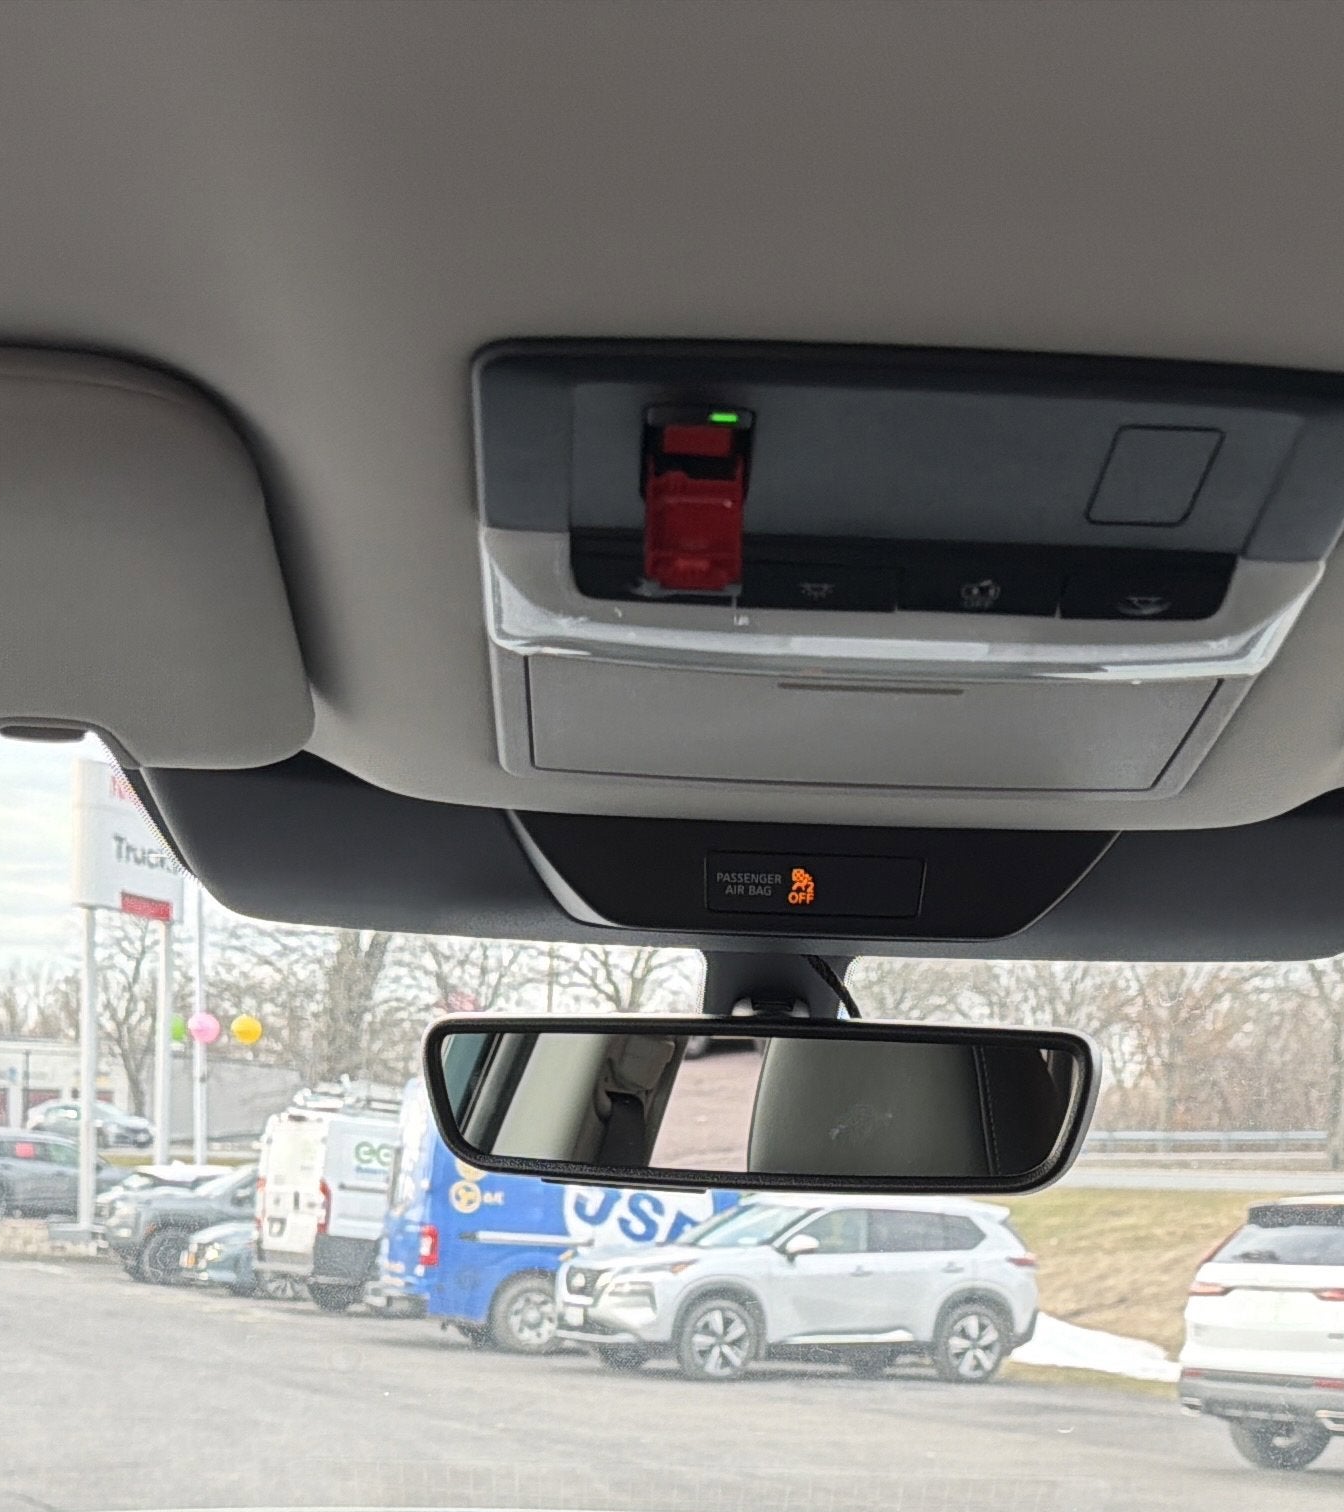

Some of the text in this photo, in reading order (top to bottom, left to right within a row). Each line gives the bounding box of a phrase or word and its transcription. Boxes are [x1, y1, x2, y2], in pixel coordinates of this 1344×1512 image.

[716, 872, 782, 884] PASSENGER
[725, 884, 772, 896] AIR BAG
[788, 892, 814, 905] OFF
